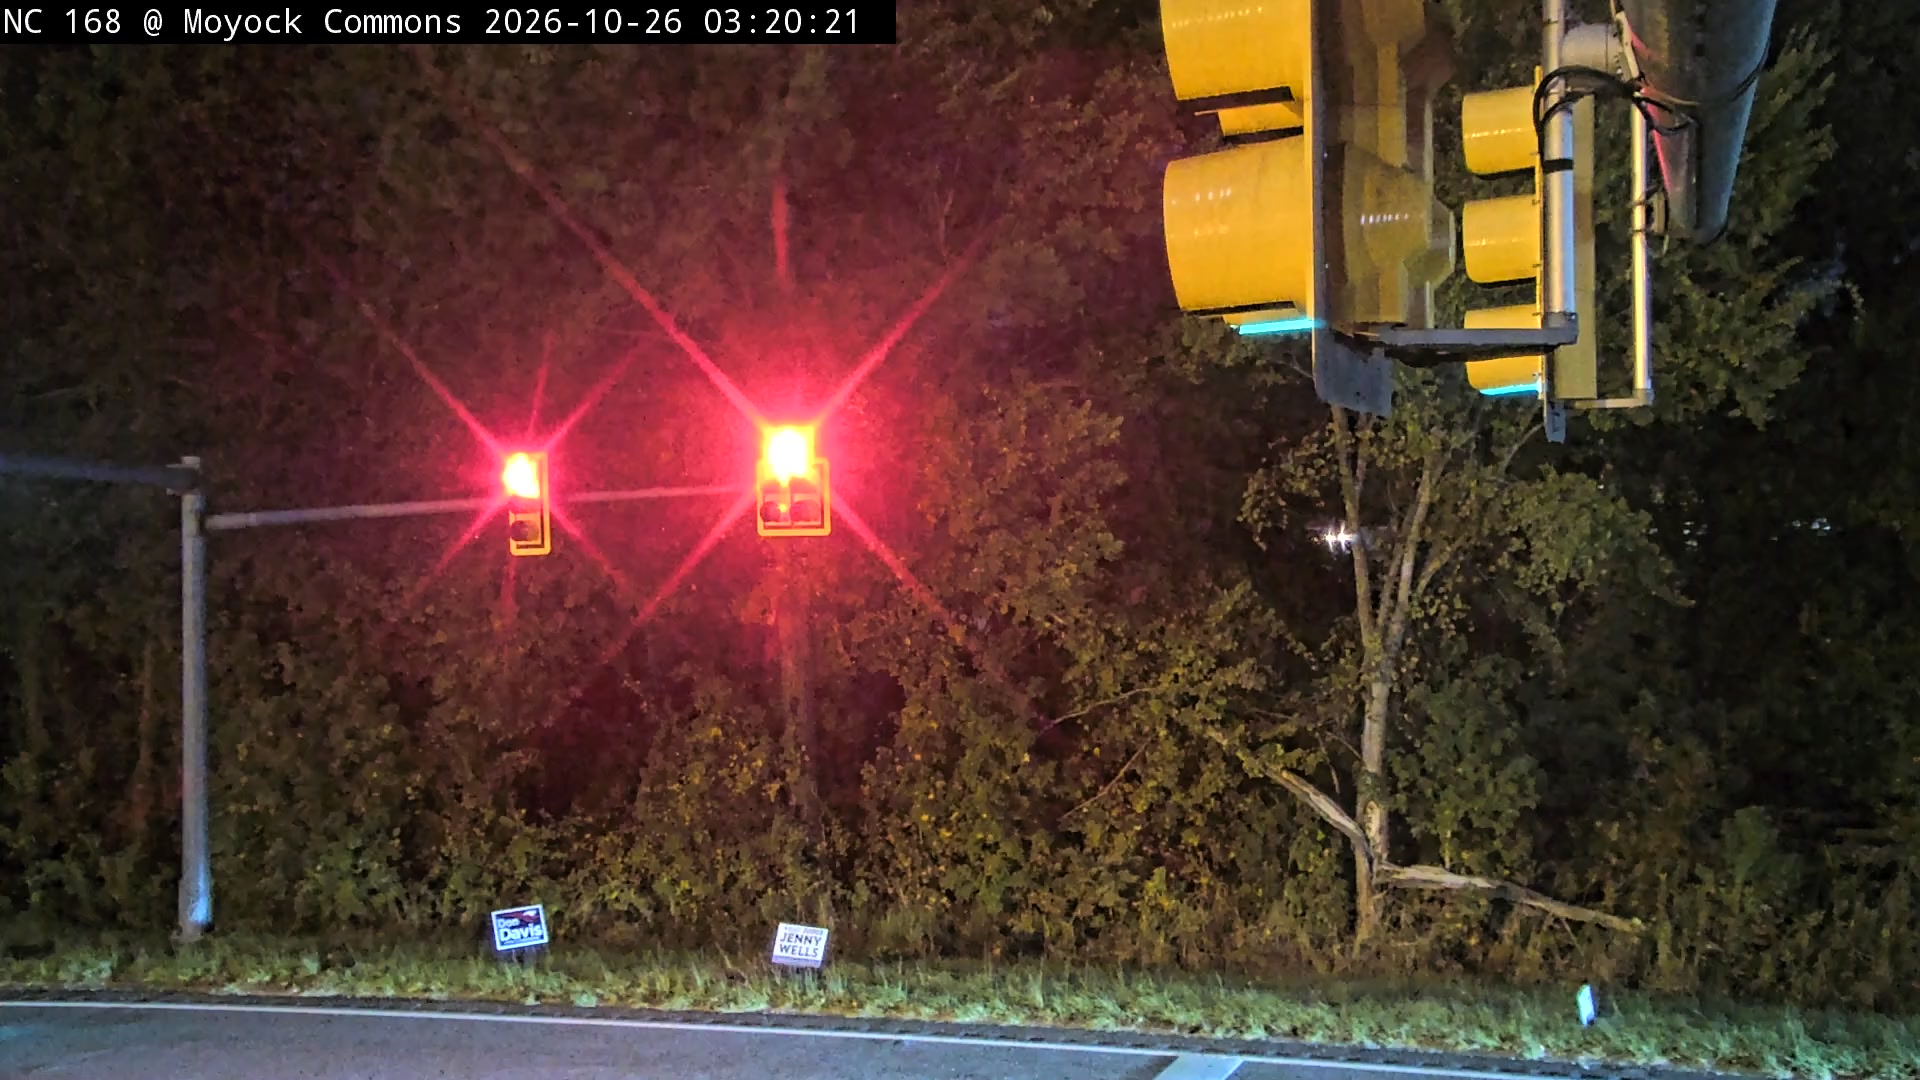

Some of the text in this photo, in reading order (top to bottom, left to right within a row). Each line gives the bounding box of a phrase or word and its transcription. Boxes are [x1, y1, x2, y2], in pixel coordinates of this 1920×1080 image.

[499, 923, 542, 942] Davis
[780, 932, 822, 946] JENNY
[779, 944, 819, 957] WELLS
